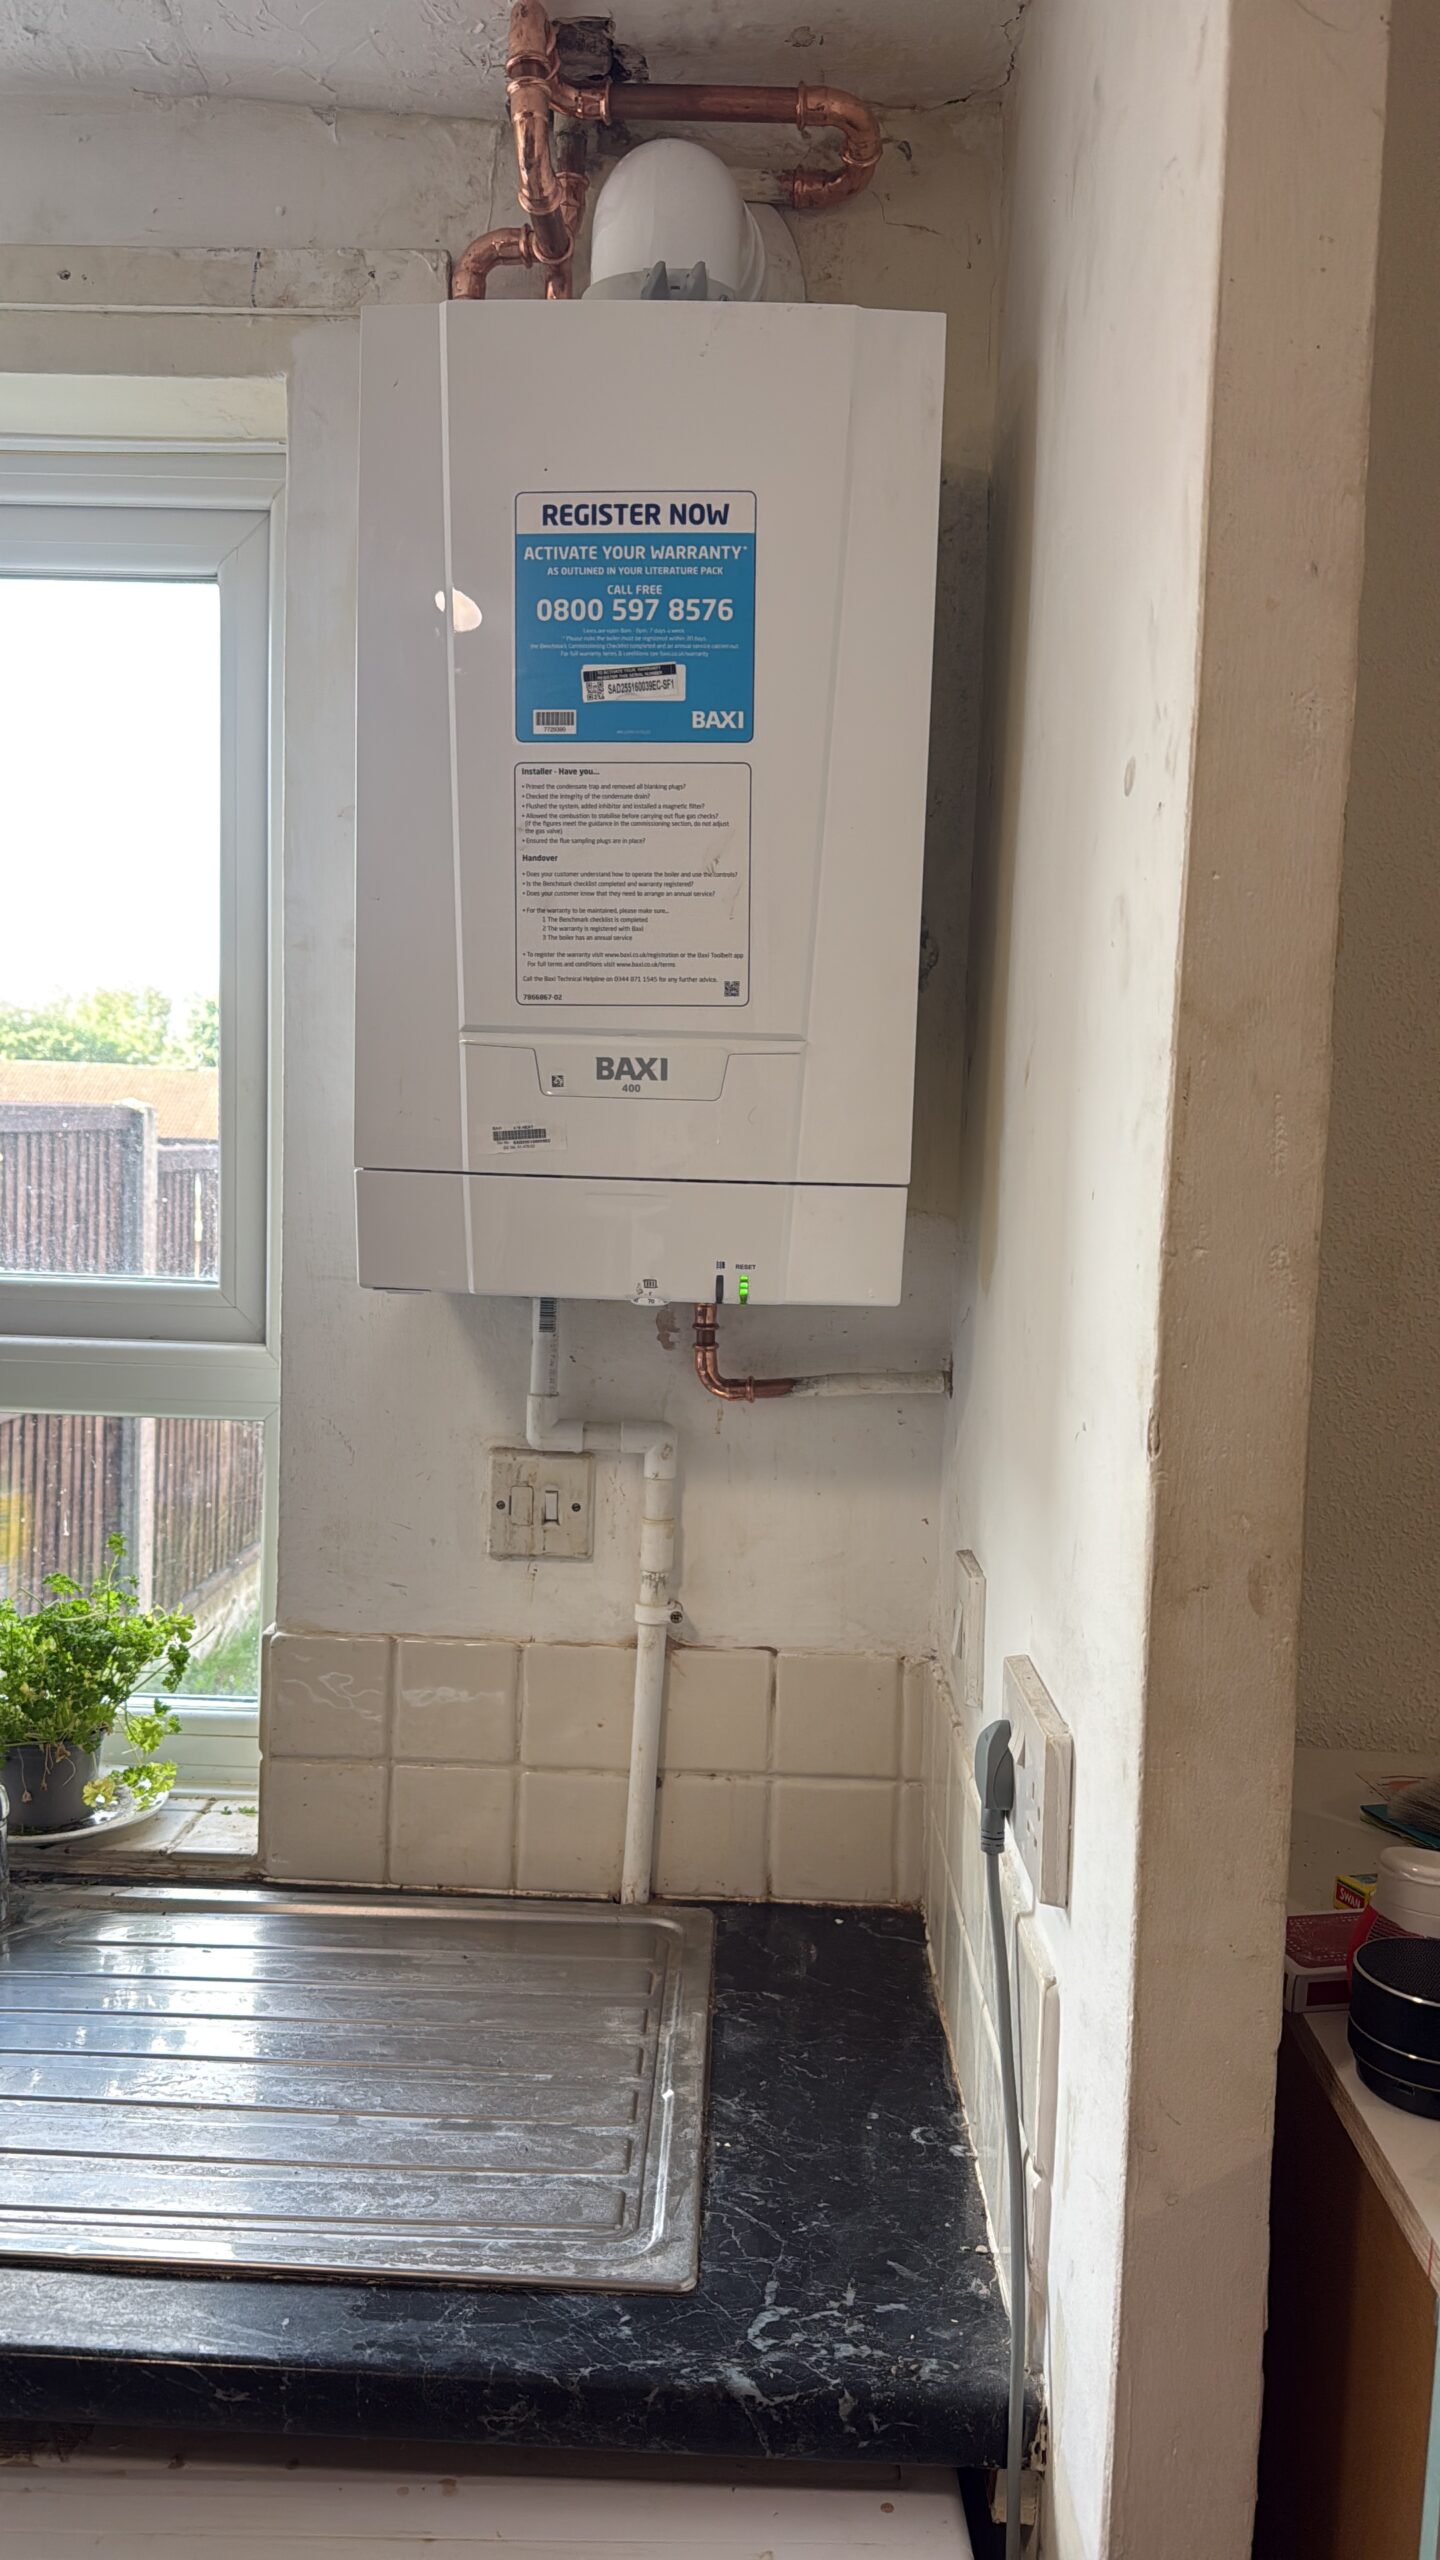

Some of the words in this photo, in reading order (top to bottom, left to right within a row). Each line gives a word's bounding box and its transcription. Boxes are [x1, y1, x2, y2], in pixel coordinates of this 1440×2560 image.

[543, 503, 661, 526] REGISTER
[670, 503, 729, 525] NOW
[524, 546, 597, 560] ACTIVATE
[602, 546, 645, 560] YOUR
[547, 567, 559, 575] AS
[561, 567, 604, 575] OUTLINED
[606, 567, 616, 575] IN
[618, 567, 643, 575] YOUR
[645, 567, 698, 575] LITERATURE
[700, 567, 723, 575] PACK
[607, 585, 632, 595] CALL
[636, 585, 662, 595] FREE
[537, 599, 603, 621] 0800
[613, 599, 659, 621] 597
[669, 599, 733, 621] 8576
[692, 711, 744, 729] BAXI
[521, 767, 552, 775] Installer
[558, 767, 578, 775] Have
[522, 854, 558, 862] Handover
[595, 1057, 668, 1081] BAXI
[621, 1084, 641, 1093] 400
[1339, 1887, 1361, 1908] SWAN
